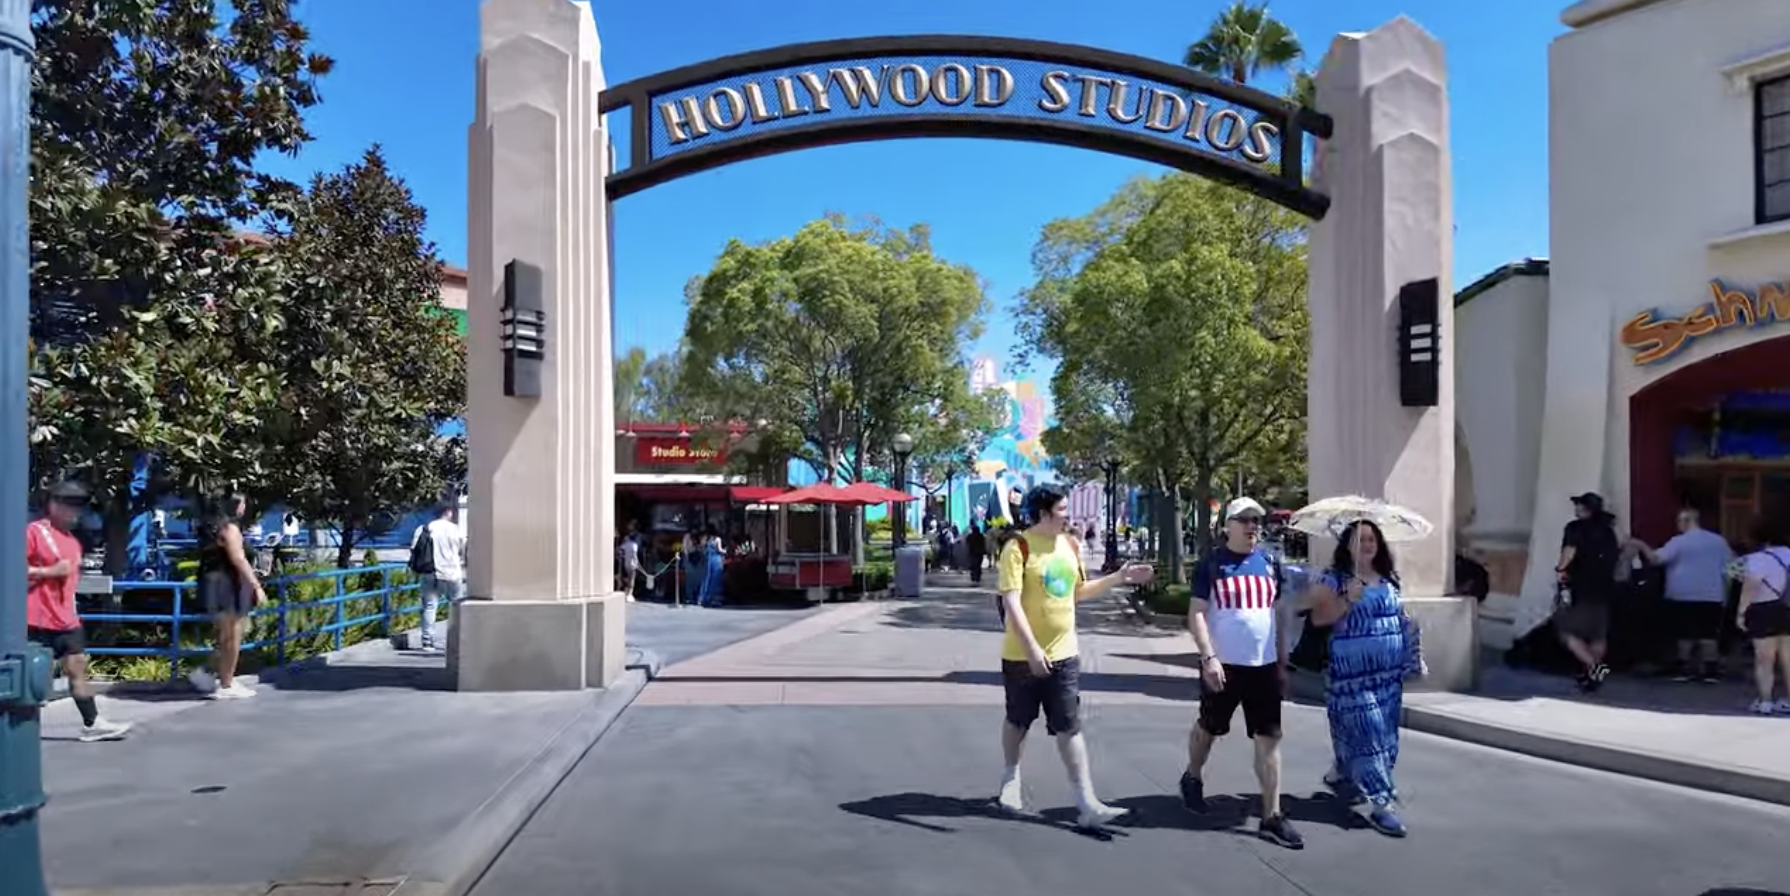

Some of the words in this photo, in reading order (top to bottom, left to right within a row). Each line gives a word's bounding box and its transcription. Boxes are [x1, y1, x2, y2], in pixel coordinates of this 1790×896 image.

[659, 62, 1014, 144] HOLLYWOOD
[1038, 70, 1279, 162] STUDIOS
[651, 445, 686, 457] Studio
